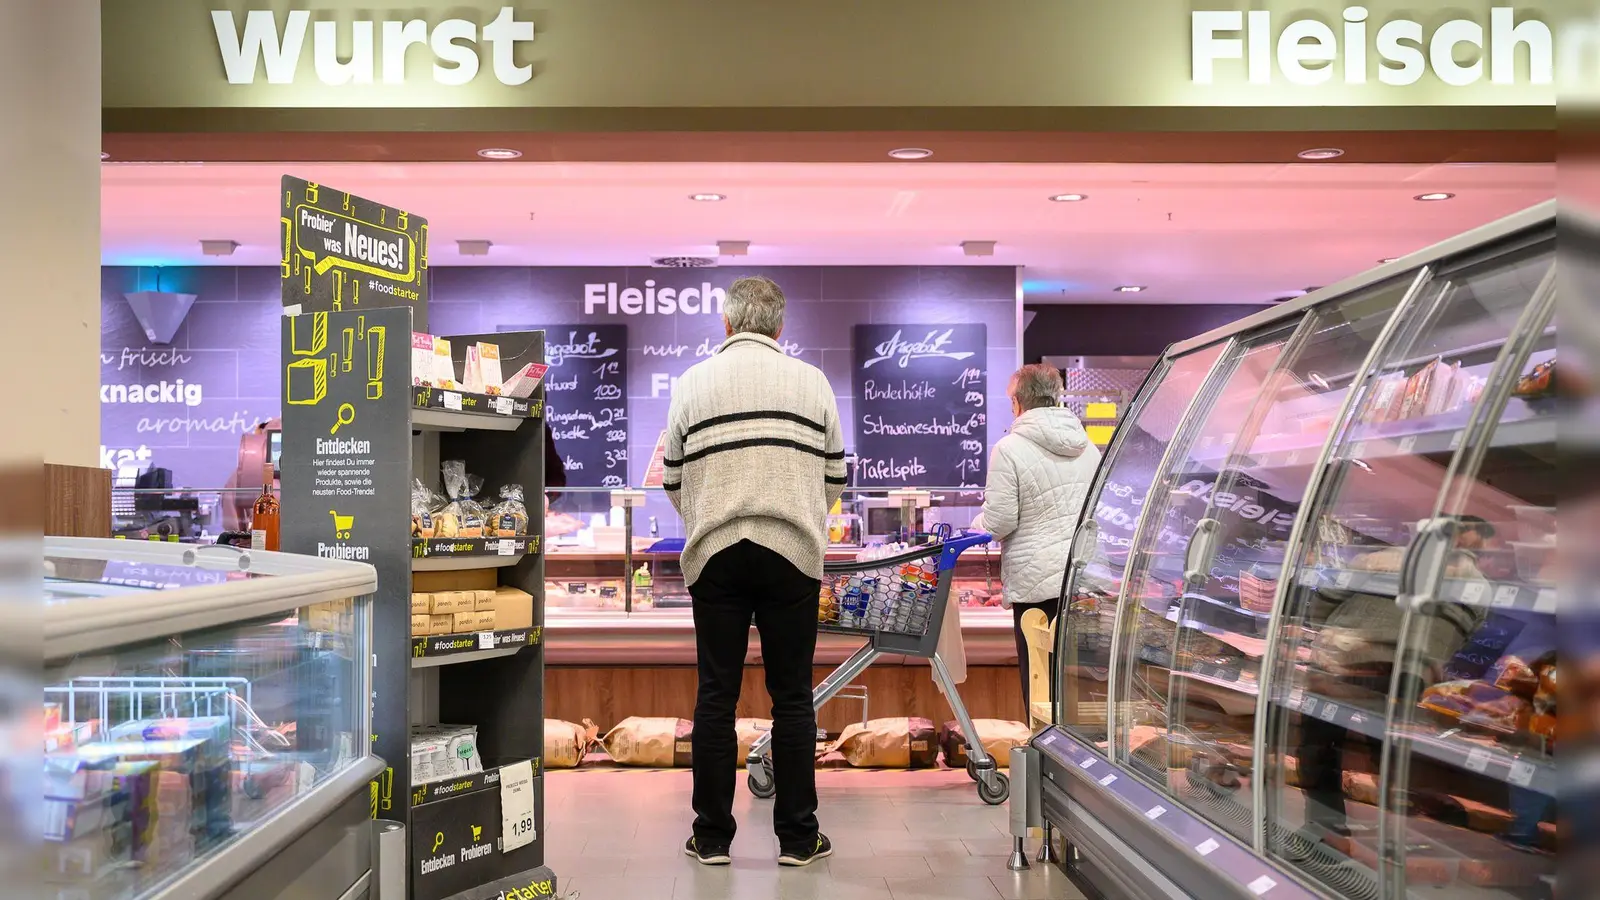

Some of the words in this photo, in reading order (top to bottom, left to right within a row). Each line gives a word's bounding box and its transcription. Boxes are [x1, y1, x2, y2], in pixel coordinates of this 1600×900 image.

[212, 6, 535, 86] Wurst
[1191, 6, 1553, 86] Fleisch
[323, 237, 342, 254] was
[344, 222, 404, 270] Neues!
[368, 280, 419, 301] #foodstarter
[584, 279, 726, 315] Fleisch
[545, 331, 603, 366] ngebot
[643, 344, 689, 357] nur
[695, 338, 721, 357] da
[118, 347, 192, 371] frisch
[316, 437, 371, 455] Entdecken
[100, 444, 152, 470] kat
[326, 458, 346, 466] findest
[346, 458, 356, 466] Du
[356, 458, 376, 466] immer
[337, 468, 371, 477] spannende
[858, 456, 927, 481] Tafelspitz
[344, 478, 362, 486] sowie
[362, 478, 373, 486] die
[317, 542, 370, 560] Probieren
[434, 639, 474, 651] #foodstarter
[434, 779, 474, 796] #foodstarter
[511, 817, 533, 837] 1,99
[420, 853, 456, 875] Entdecken
[460, 842, 492, 862] Probieren
